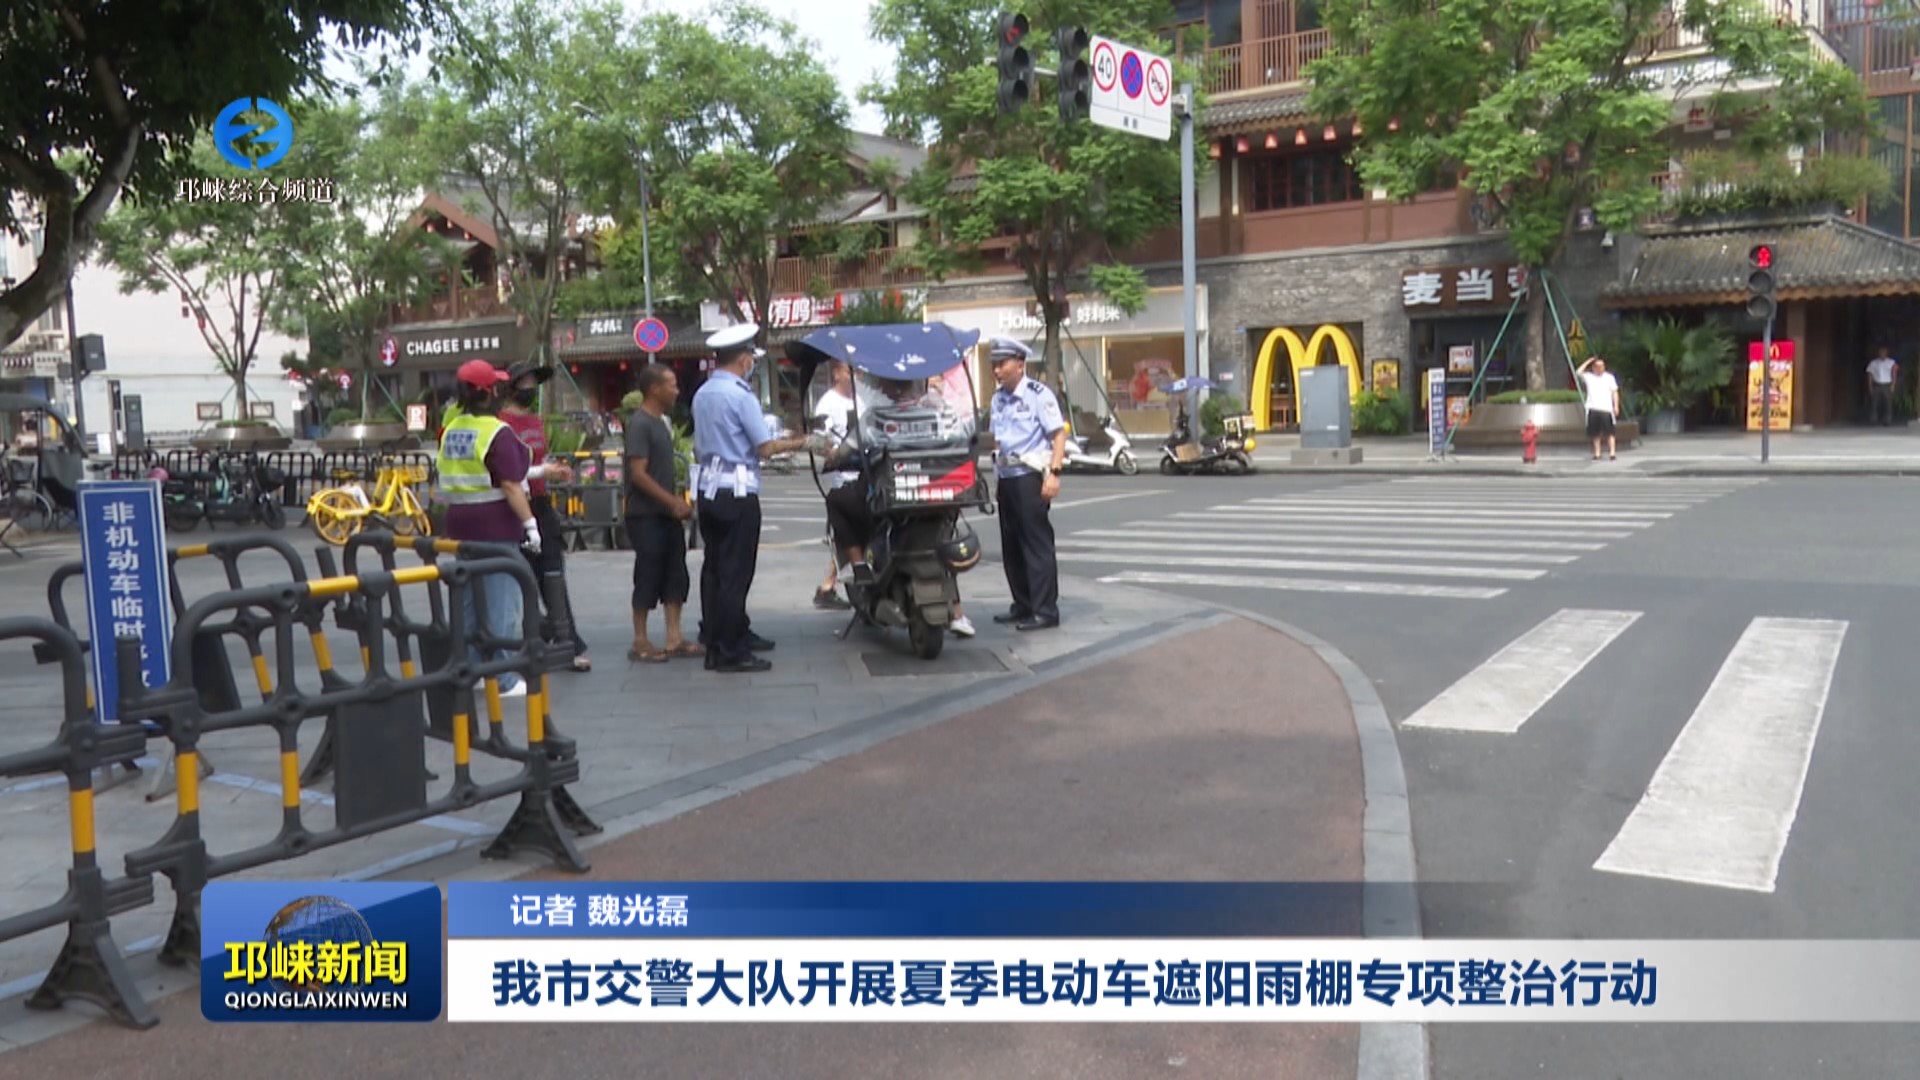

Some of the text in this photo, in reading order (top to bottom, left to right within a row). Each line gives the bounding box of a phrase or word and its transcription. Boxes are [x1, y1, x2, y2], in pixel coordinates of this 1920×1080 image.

[1097, 54, 1113, 80] 40
[406, 337, 460, 356] CHAGEE
[103, 501, 151, 688] 非机动车临时
